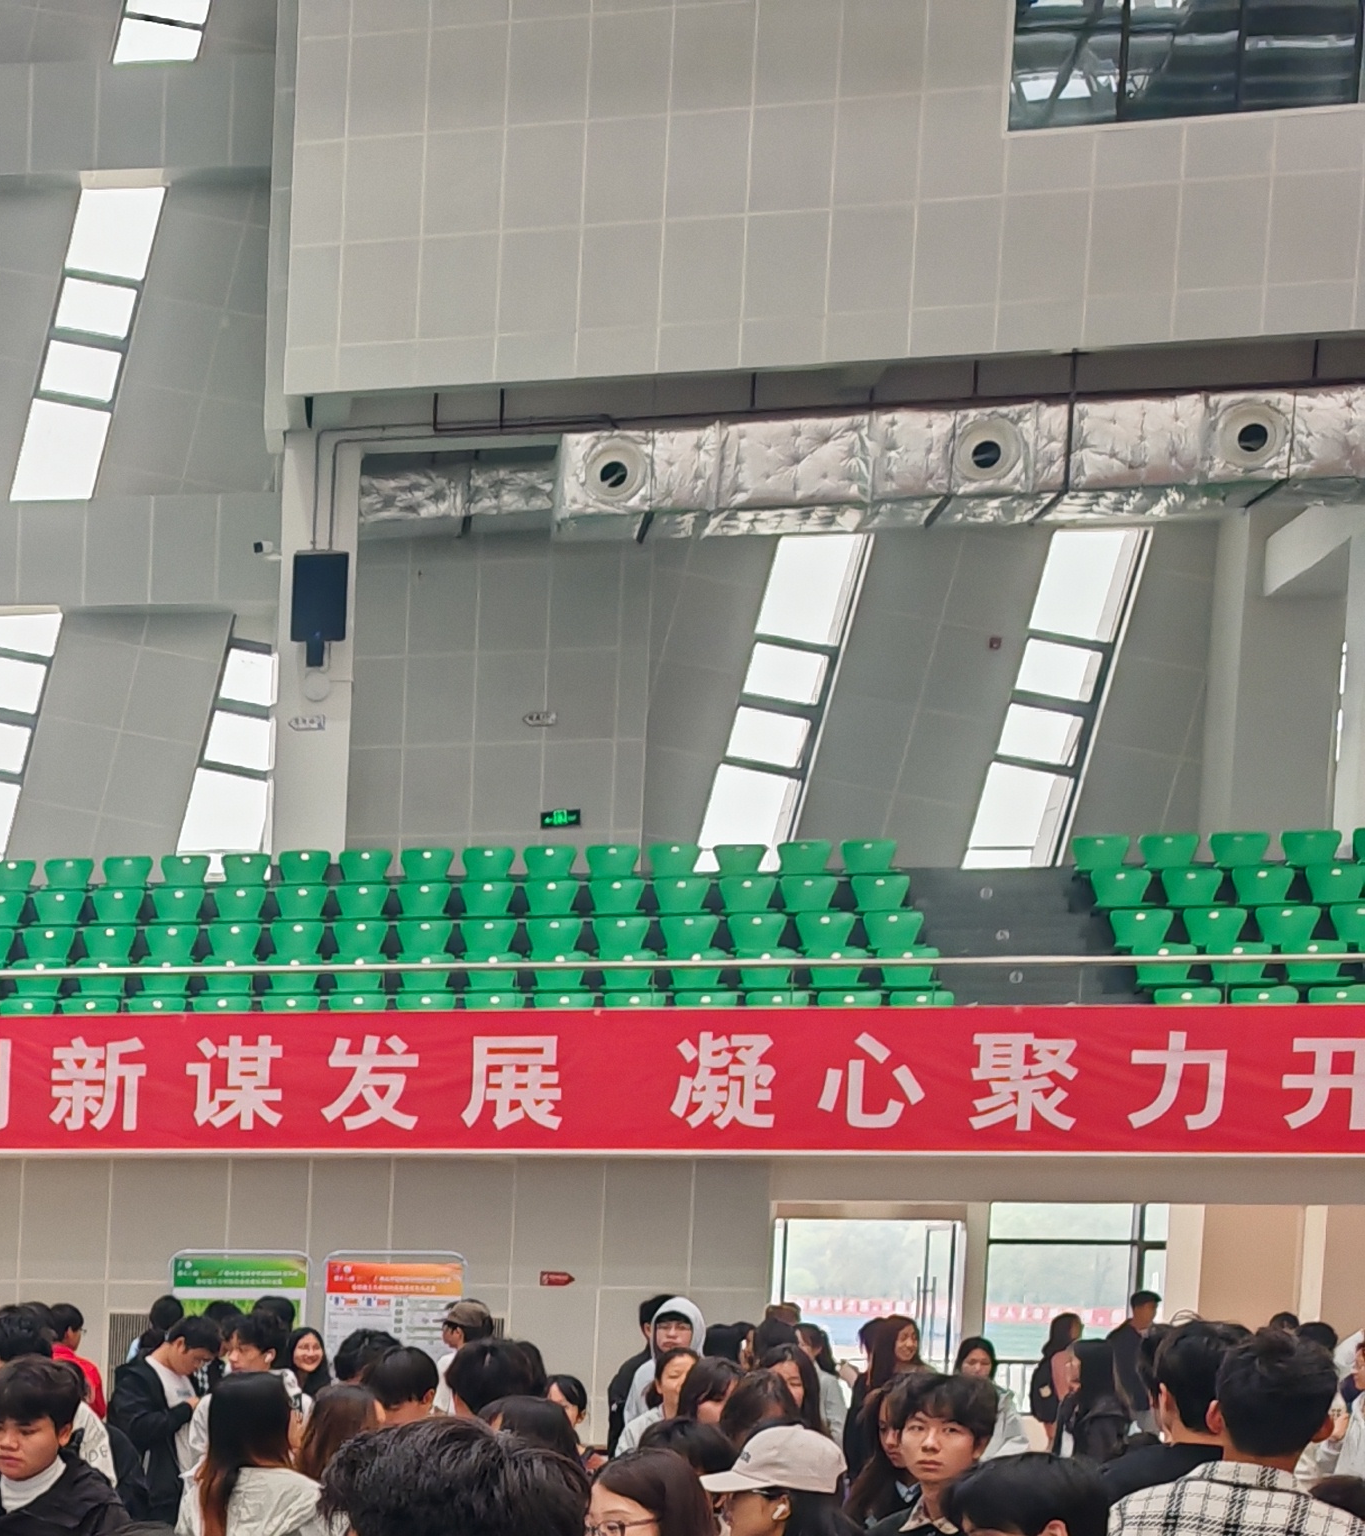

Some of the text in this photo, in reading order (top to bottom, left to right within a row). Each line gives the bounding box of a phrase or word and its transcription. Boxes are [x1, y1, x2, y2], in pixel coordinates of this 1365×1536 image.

[669, 1029, 1365, 1132] 凝心聚力开
